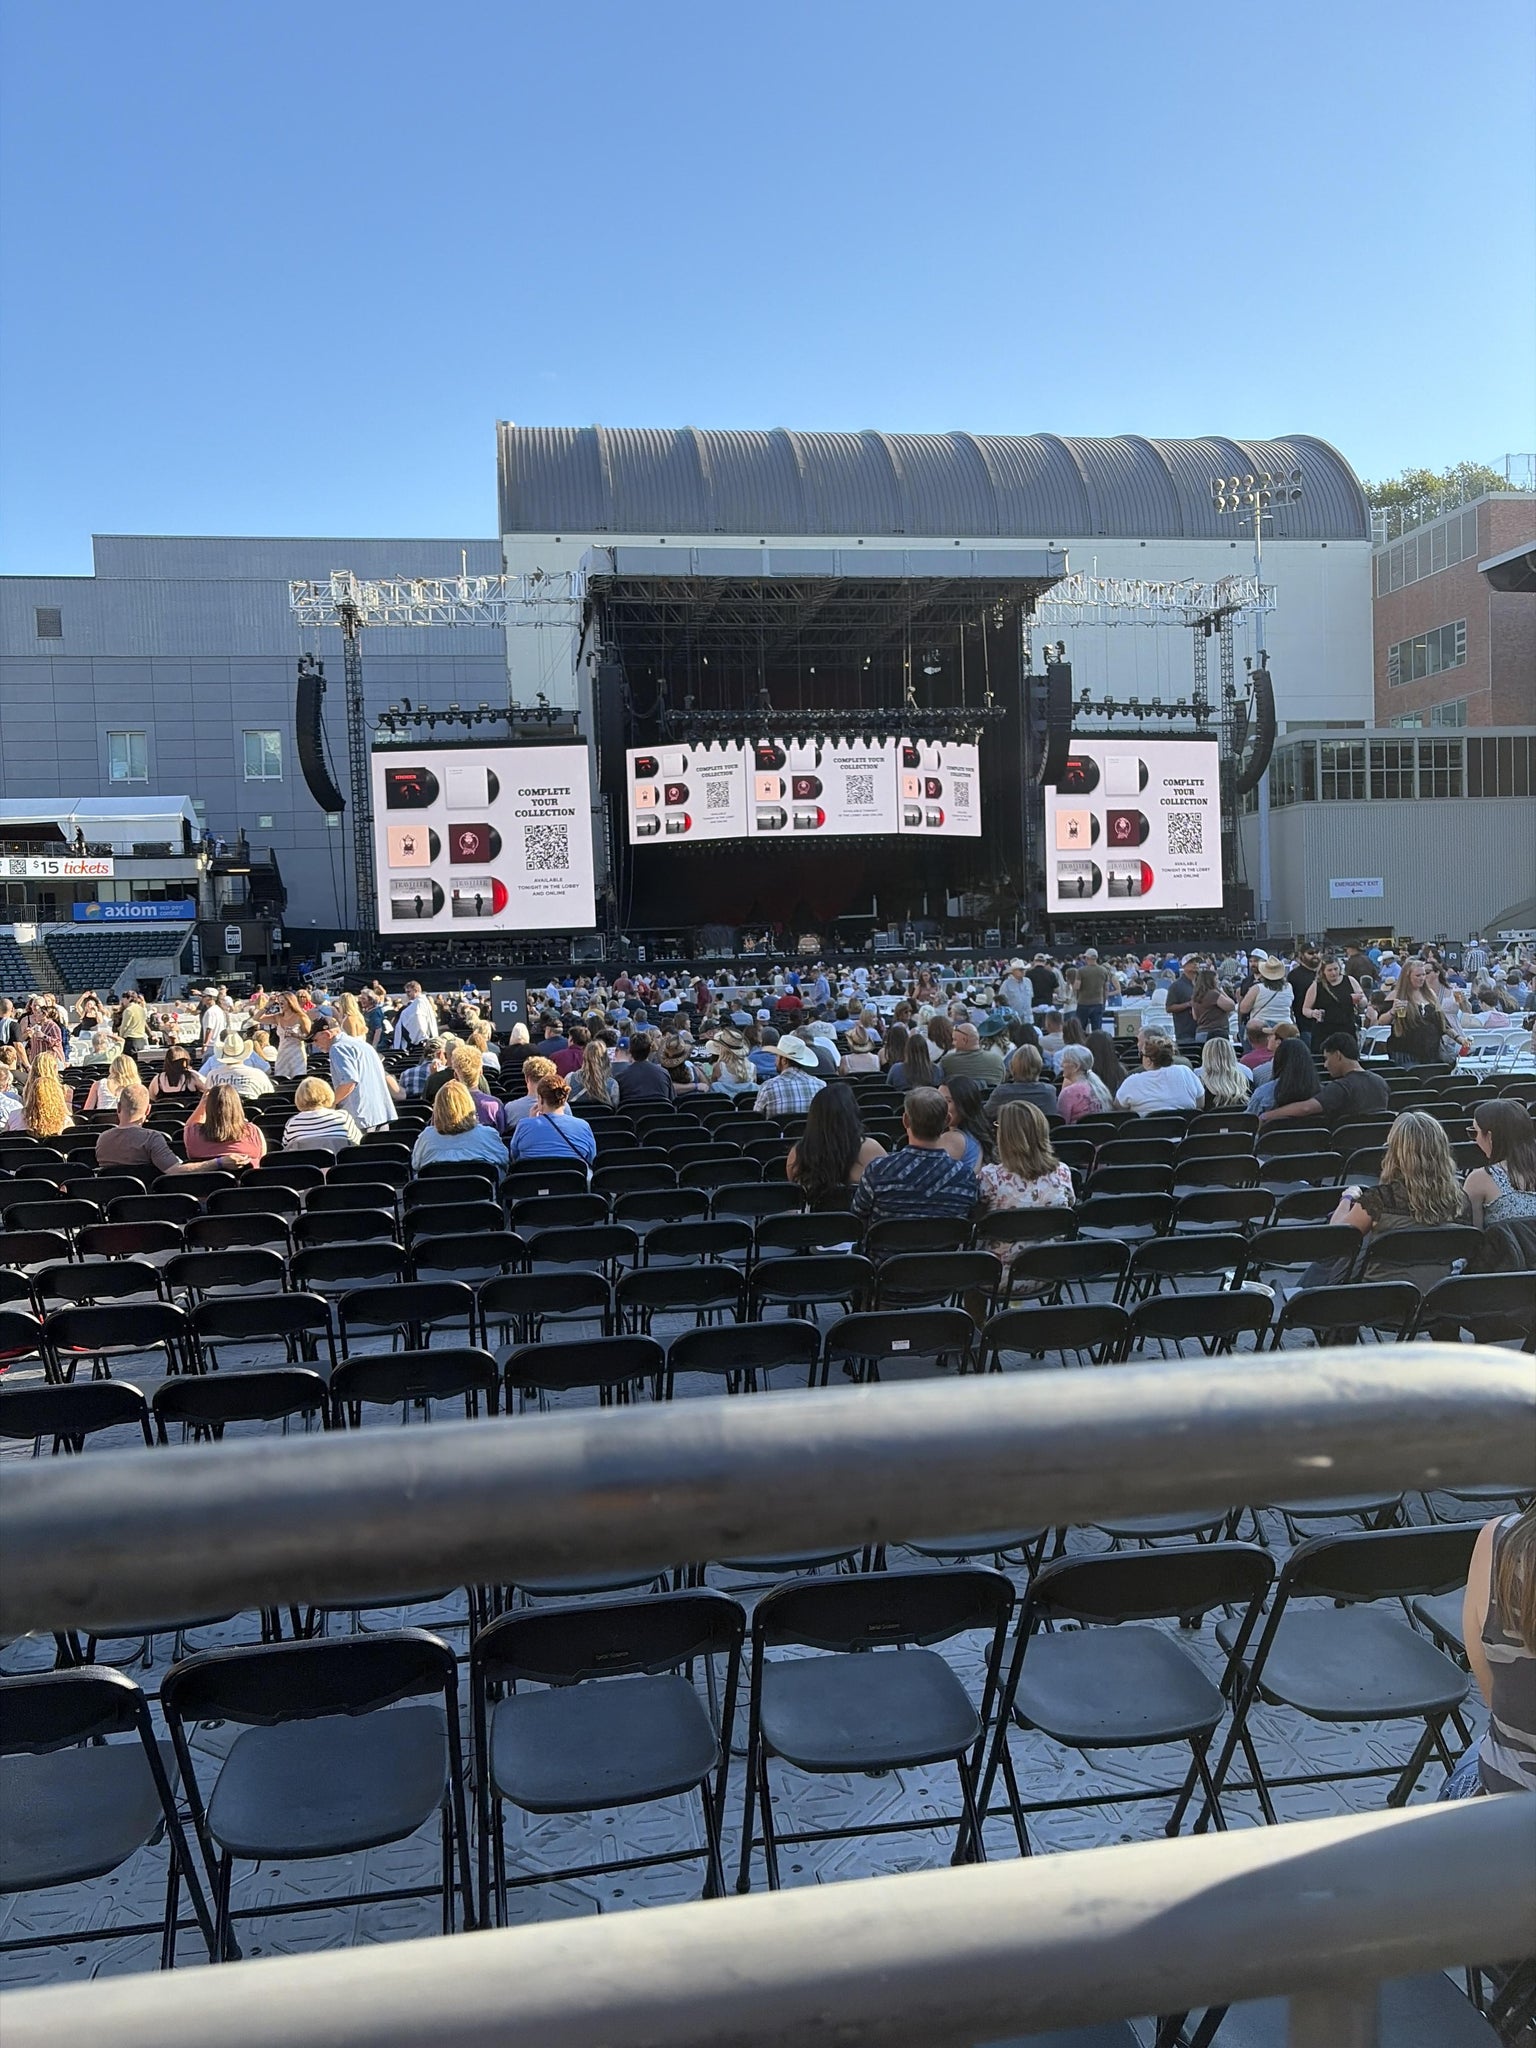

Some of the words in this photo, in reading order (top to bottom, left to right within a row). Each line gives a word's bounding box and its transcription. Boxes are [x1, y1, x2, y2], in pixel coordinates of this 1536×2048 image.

[518, 787, 571, 796] COMPLETE
[1173, 788, 1195, 796] YOUR
[531, 798, 558, 806] YOUR
[1160, 798, 1208, 806] COLLECTION
[515, 808, 576, 817] COLLECTION
[33, 860, 60, 874] $15
[64, 860, 109, 874] tickets
[104, 903, 157, 917] axiom
[501, 1001, 518, 1013] F6
